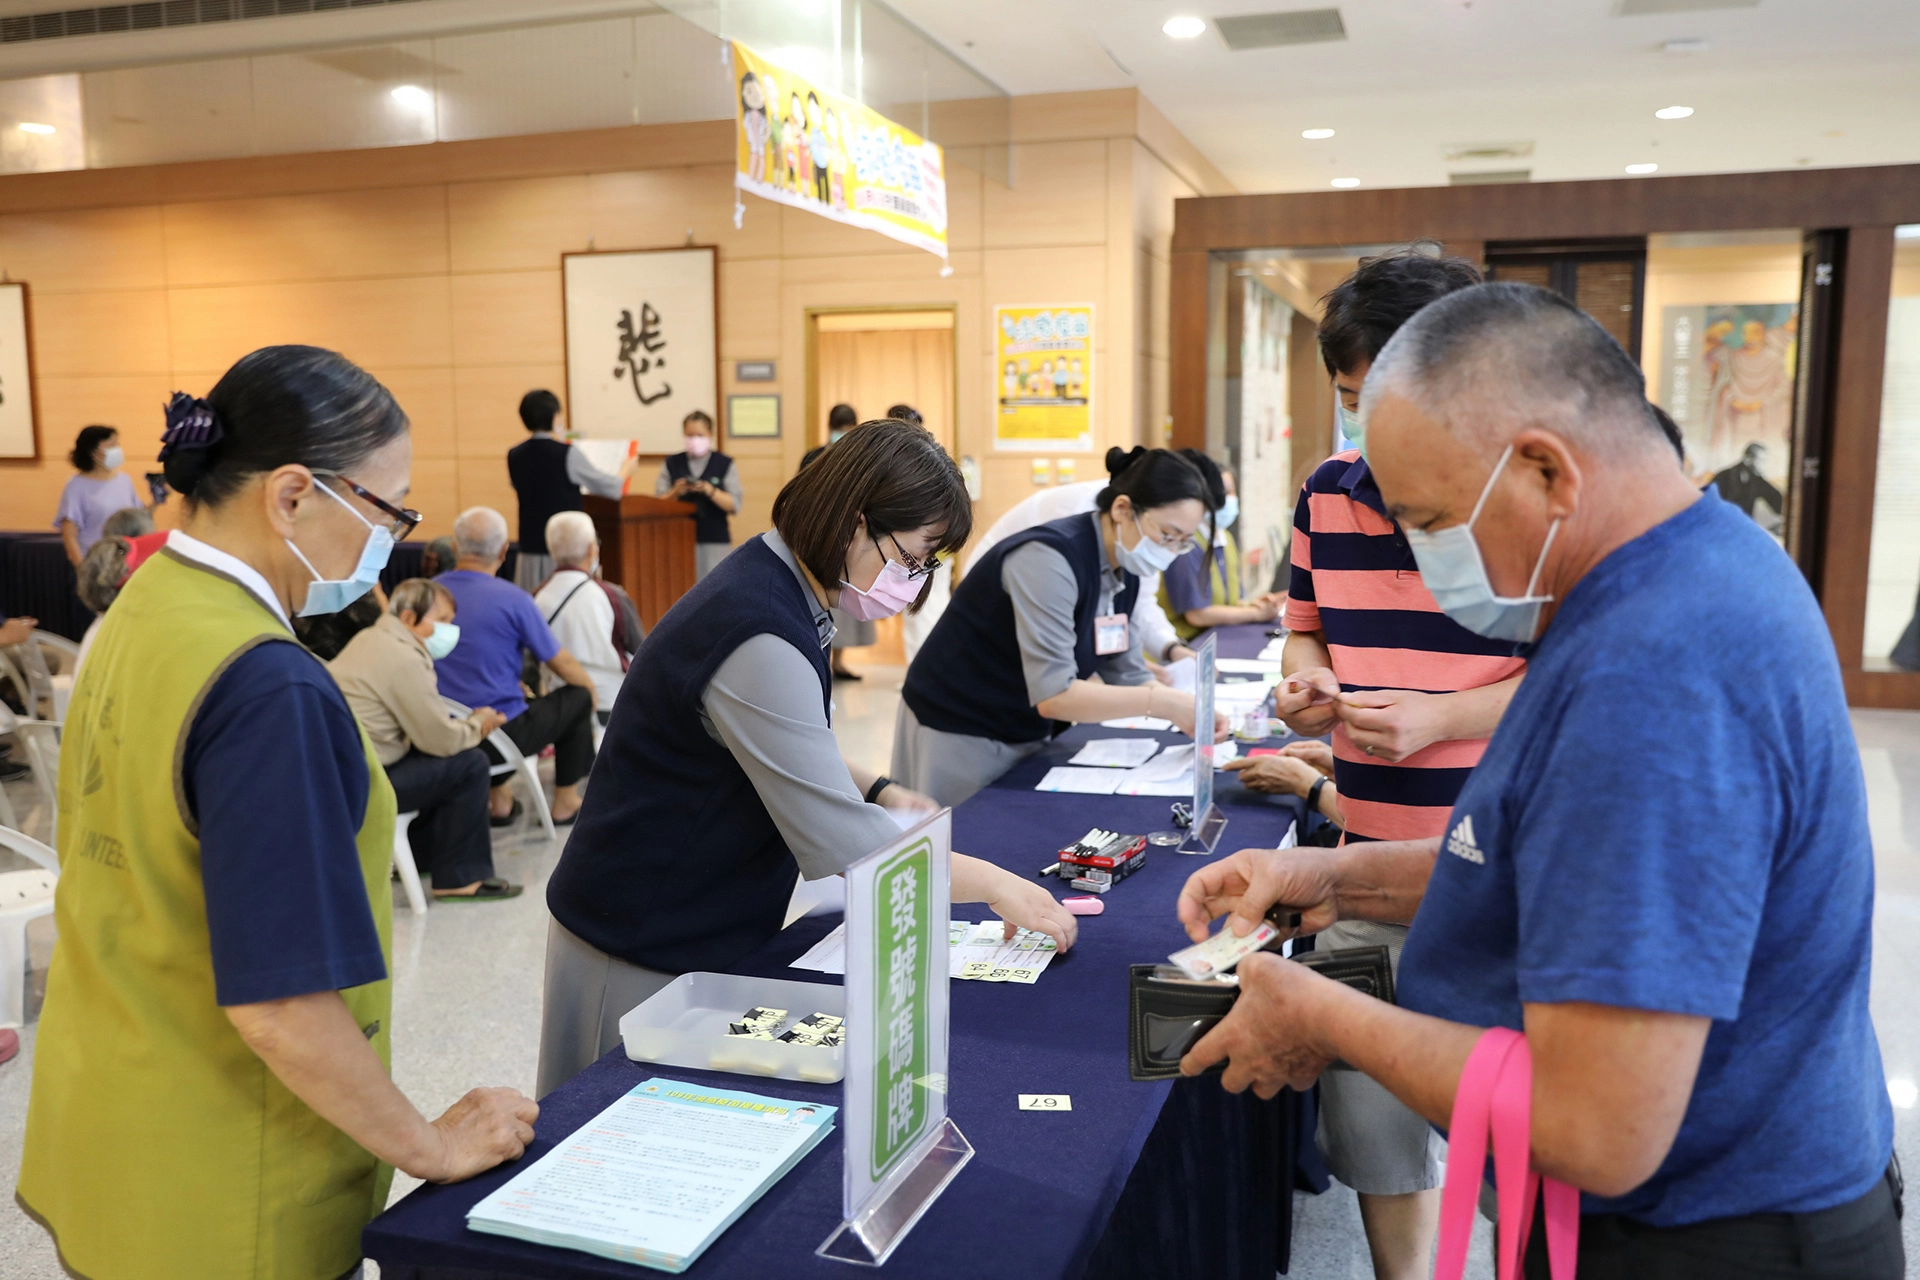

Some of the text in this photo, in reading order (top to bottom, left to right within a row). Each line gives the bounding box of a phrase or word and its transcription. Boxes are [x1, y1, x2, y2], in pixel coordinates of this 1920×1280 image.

[1014, 969, 1032, 979] 67
[888, 865, 917, 1151] 發號碼牌
[1029, 1098, 1058, 1108] 67
